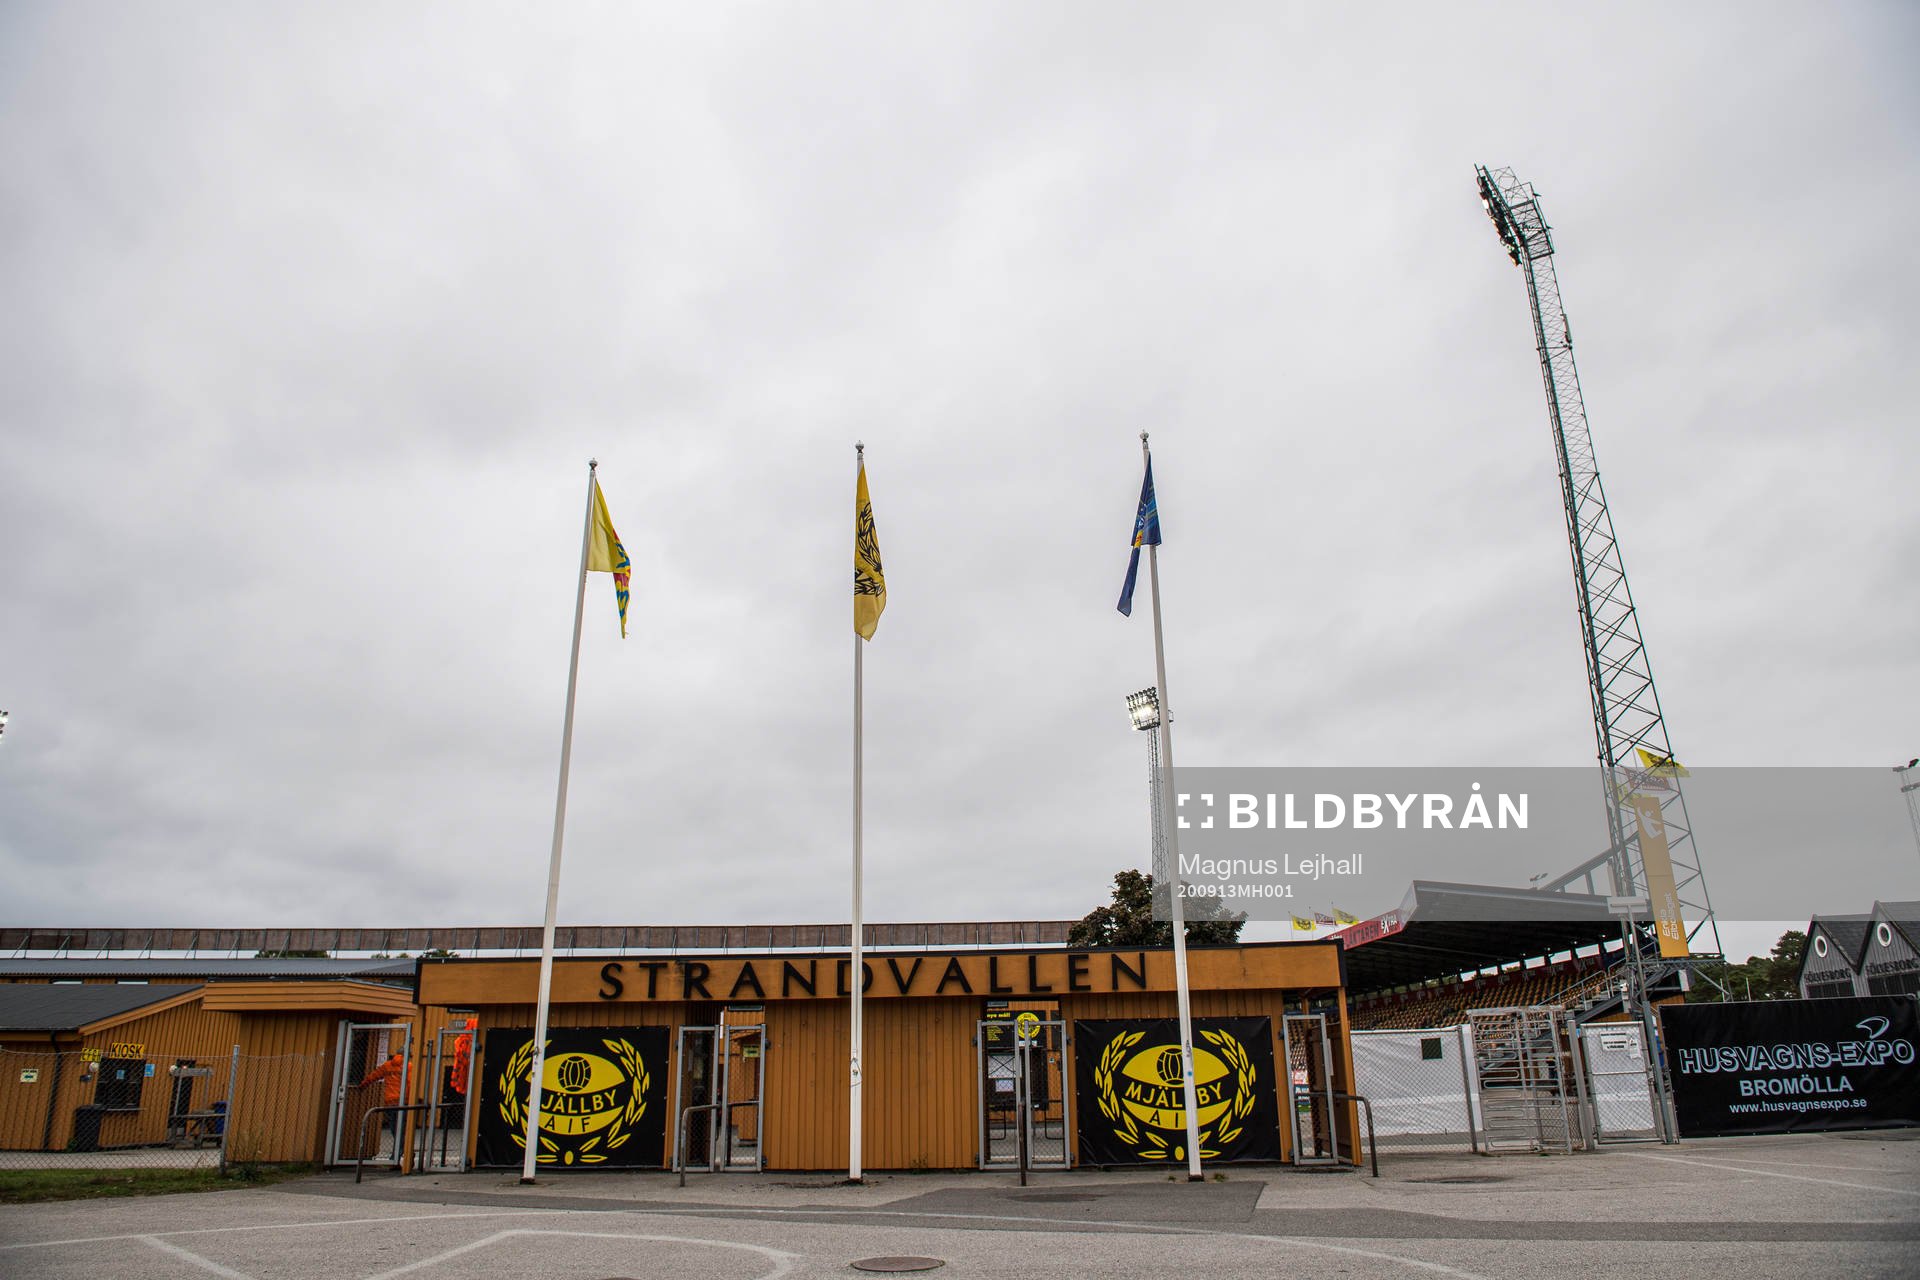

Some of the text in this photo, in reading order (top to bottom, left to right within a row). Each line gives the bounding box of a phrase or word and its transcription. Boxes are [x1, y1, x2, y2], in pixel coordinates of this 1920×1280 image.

[598, 952, 1147, 1000] STRANDVALLEN
[111, 1043, 143, 1059] KIOSK
[1679, 1038, 1915, 1074] HUSVAGNS-EXPO
[1124, 1081, 1223, 1109] MJÄLBY
[1739, 1074, 1853, 1097] BROMÖLLA
[525, 1088, 617, 1115] JÄLLBY
[1729, 1098, 1868, 1114] www.husvagnsexpo.se
[544, 1117, 592, 1133] AIF
